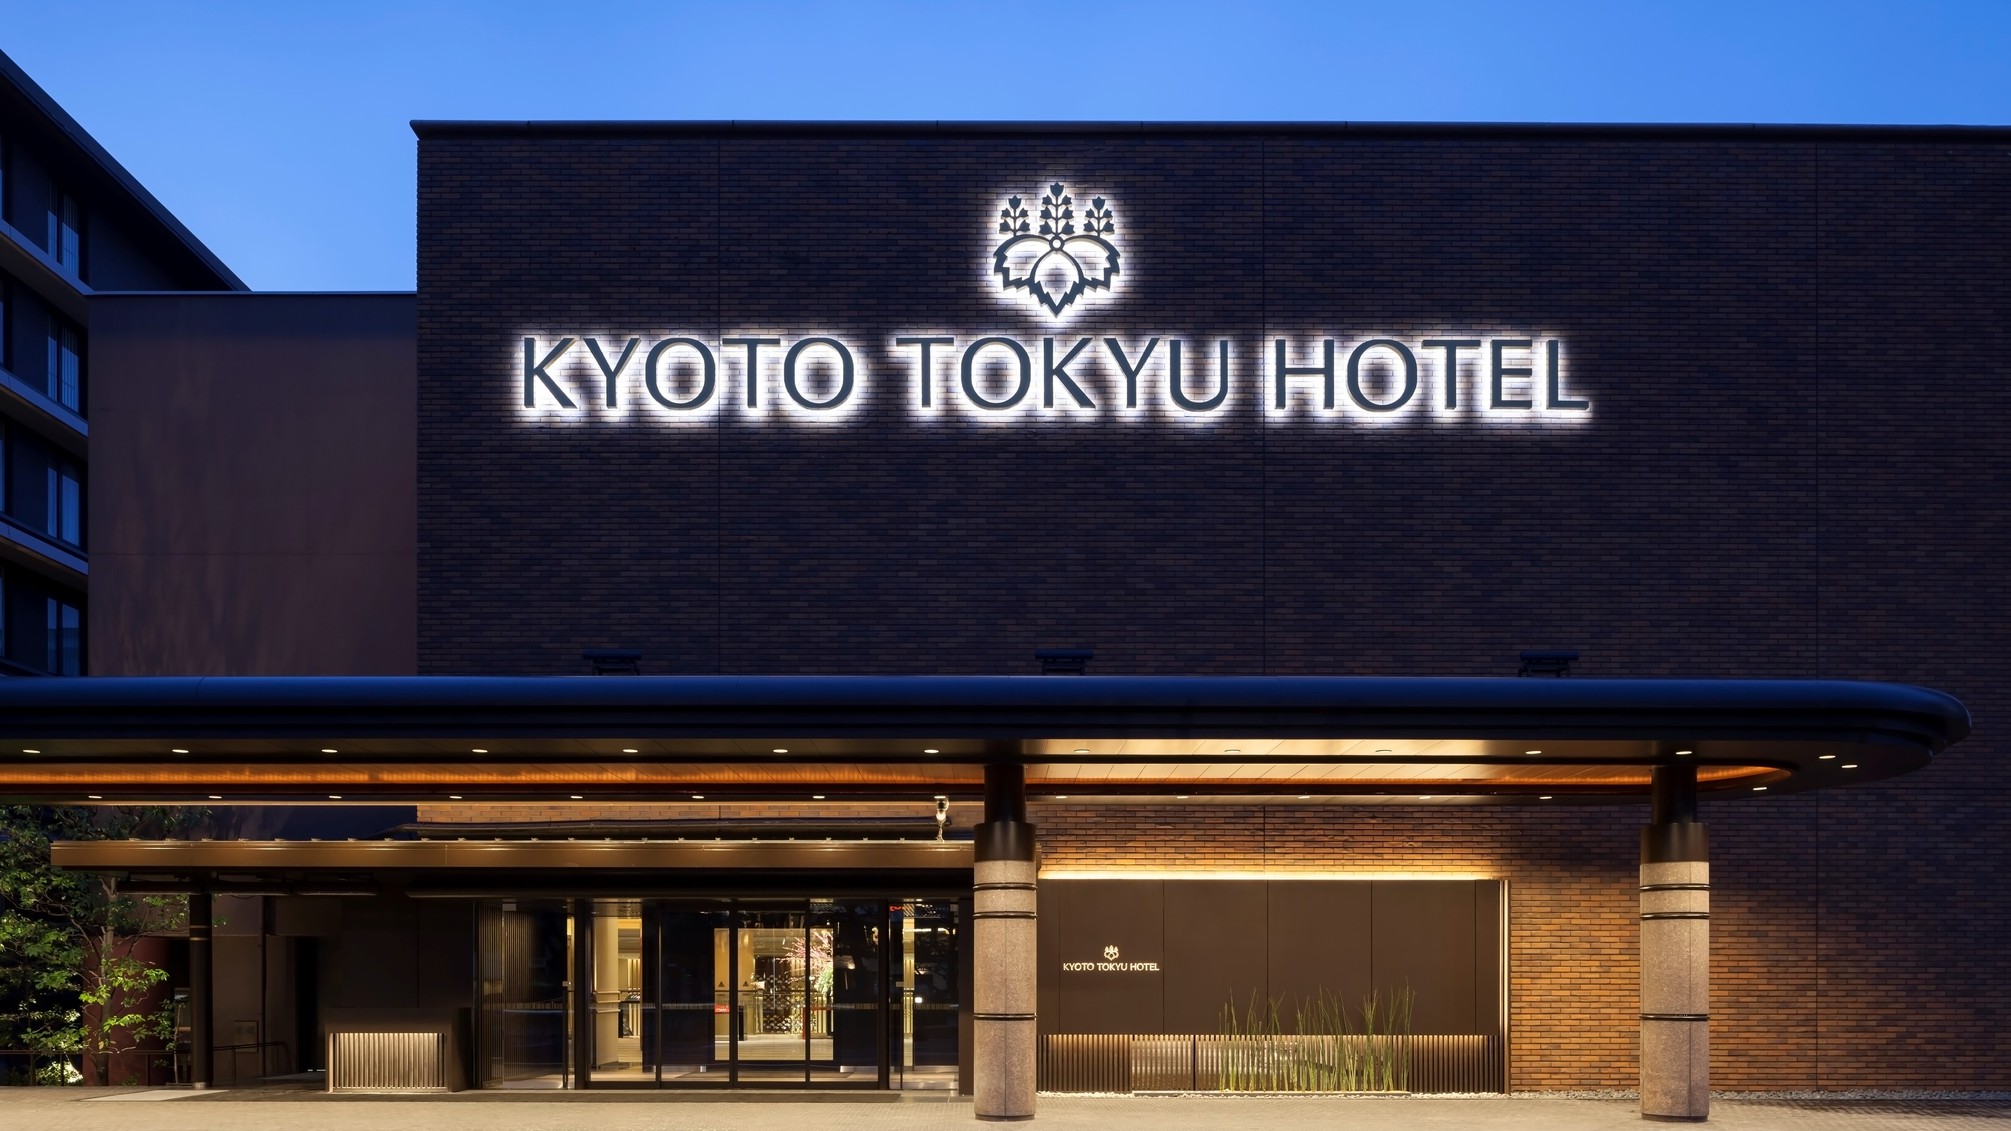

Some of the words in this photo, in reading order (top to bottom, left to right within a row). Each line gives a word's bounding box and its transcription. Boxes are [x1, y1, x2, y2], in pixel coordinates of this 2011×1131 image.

[523, 337, 855, 411] KYOTO
[896, 337, 1229, 412] TOKYU
[1275, 338, 1591, 412] HOTEL
[1063, 962, 1095, 971] KYOTO
[1096, 962, 1128, 971] TOKYU
[1130, 962, 1160, 971] HOTEL
